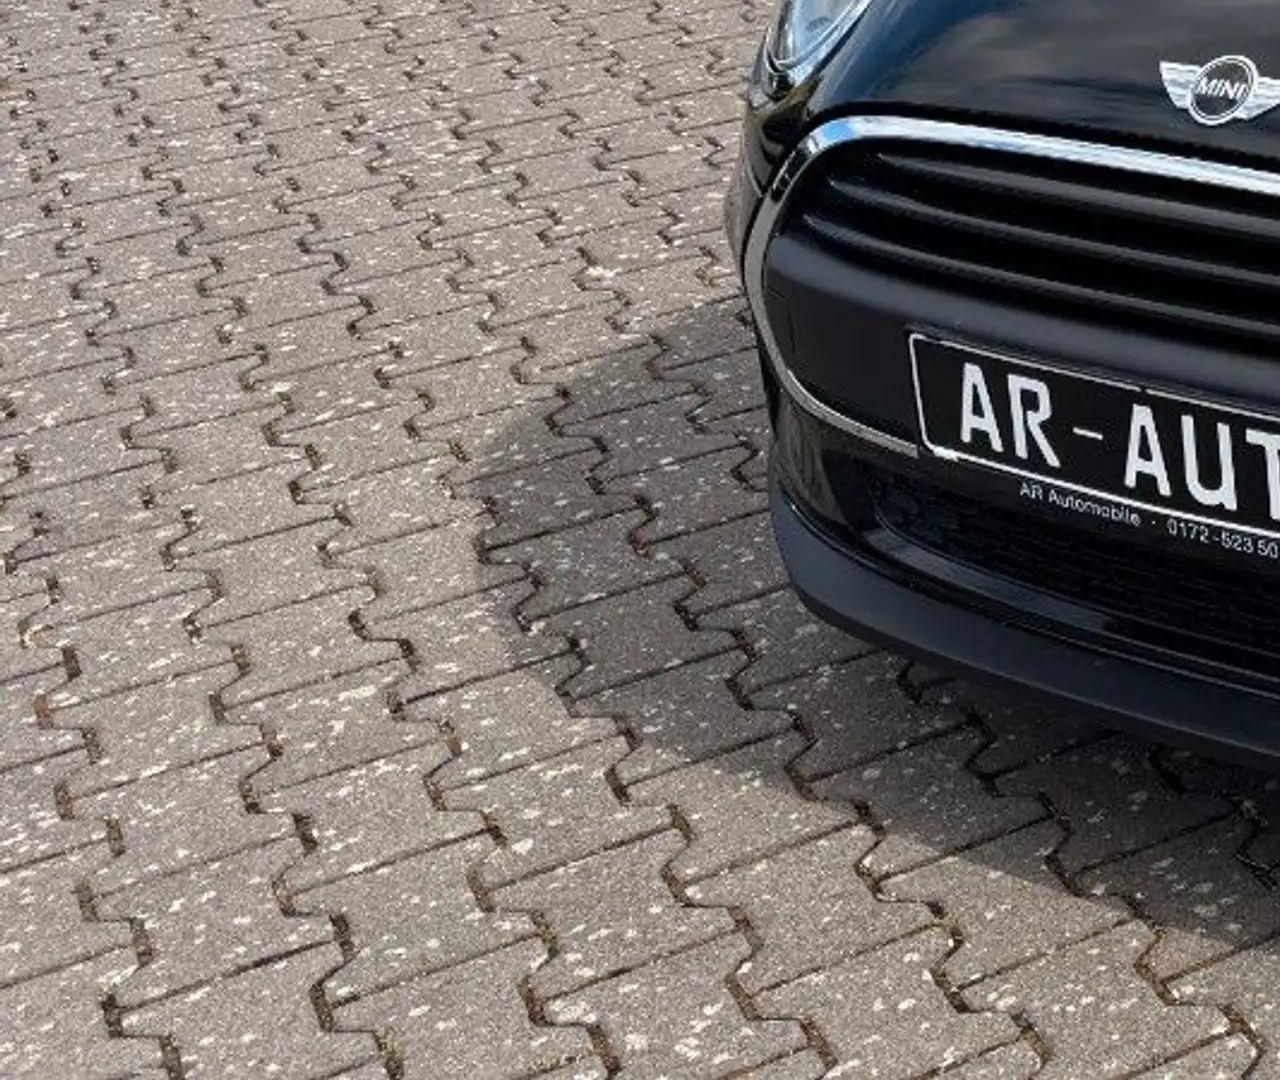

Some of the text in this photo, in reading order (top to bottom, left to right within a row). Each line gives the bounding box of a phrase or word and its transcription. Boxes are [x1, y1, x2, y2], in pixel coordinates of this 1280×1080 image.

[1195, 76, 1249, 100] MINI
[1020, 482, 1043, 500] AR
[1048, 489, 1141, 528] Automobile
[1257, 539, 1279, 559] 50
